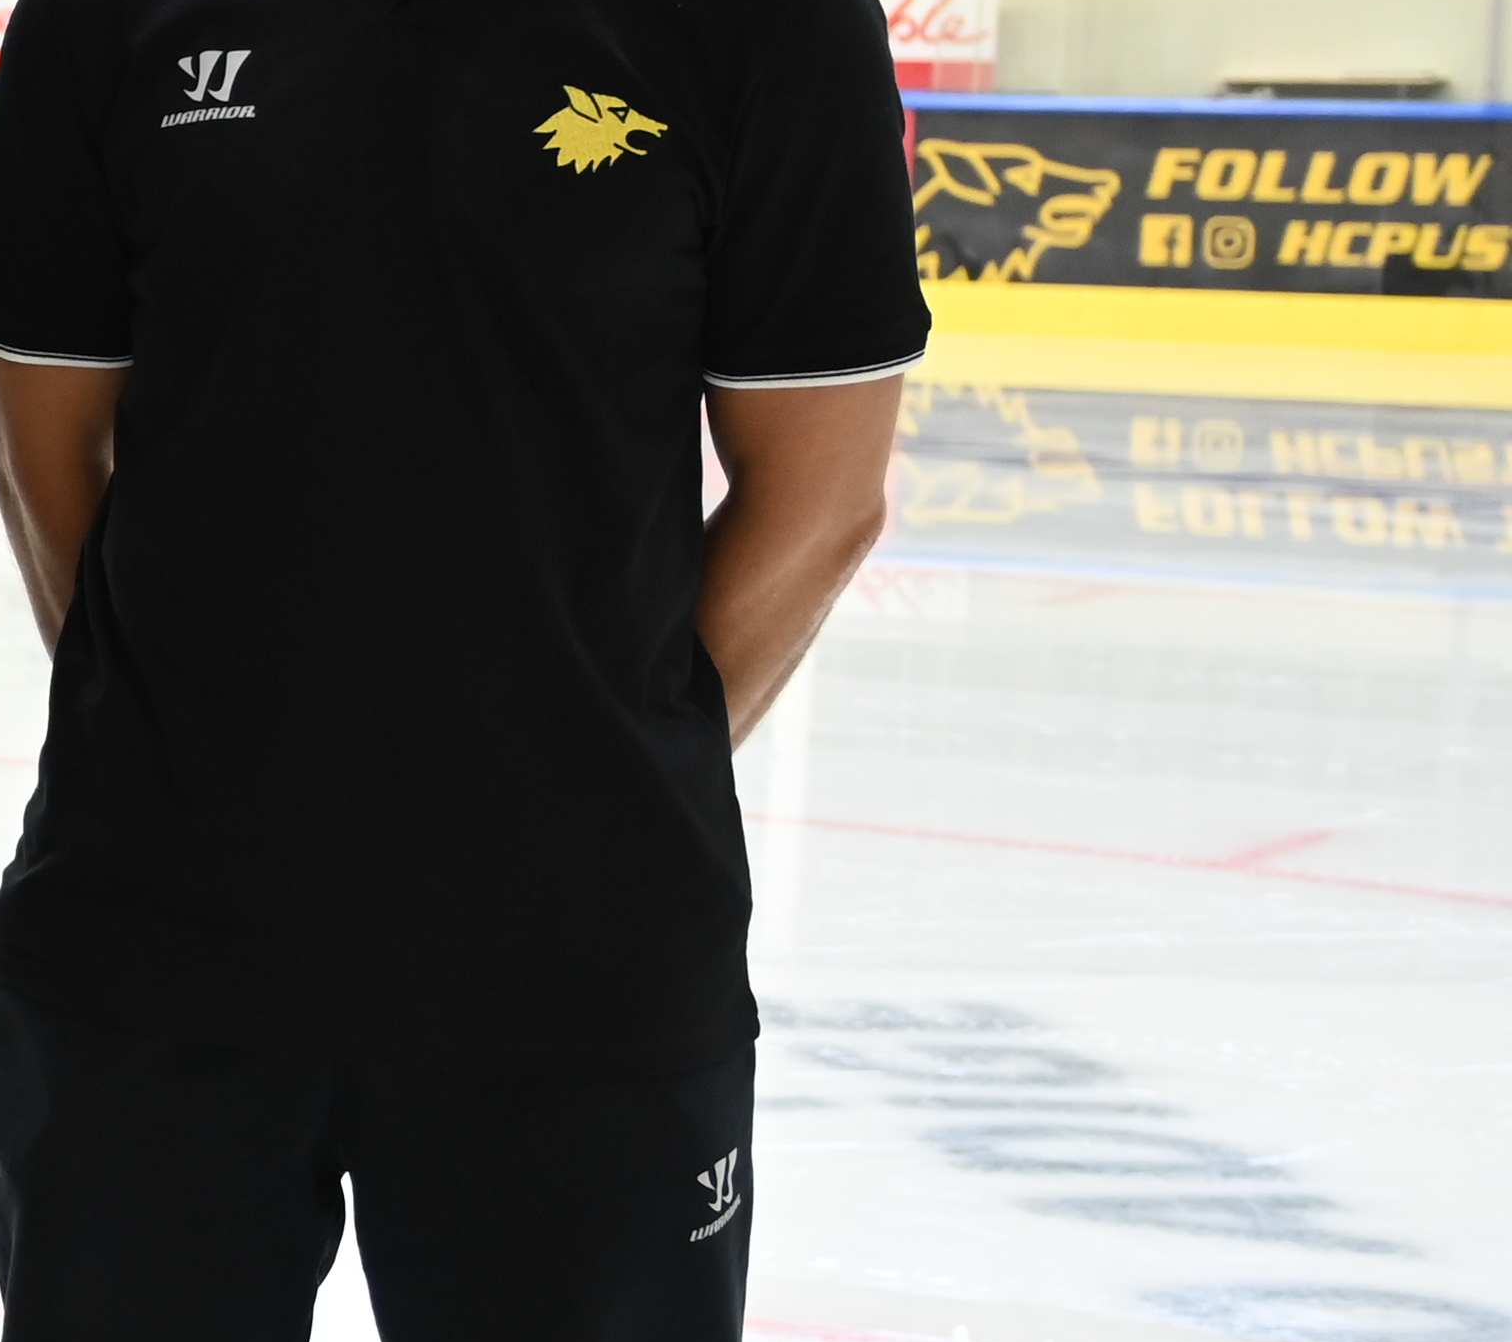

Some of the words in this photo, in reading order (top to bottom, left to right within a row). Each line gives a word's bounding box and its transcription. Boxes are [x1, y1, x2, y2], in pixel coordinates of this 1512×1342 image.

[159, 105, 256, 129] WARRIOR
[1145, 146, 1494, 207] FOLLOW
[1277, 219, 1512, 273] HCPUS
[689, 1193, 742, 1243] WARRIOR
